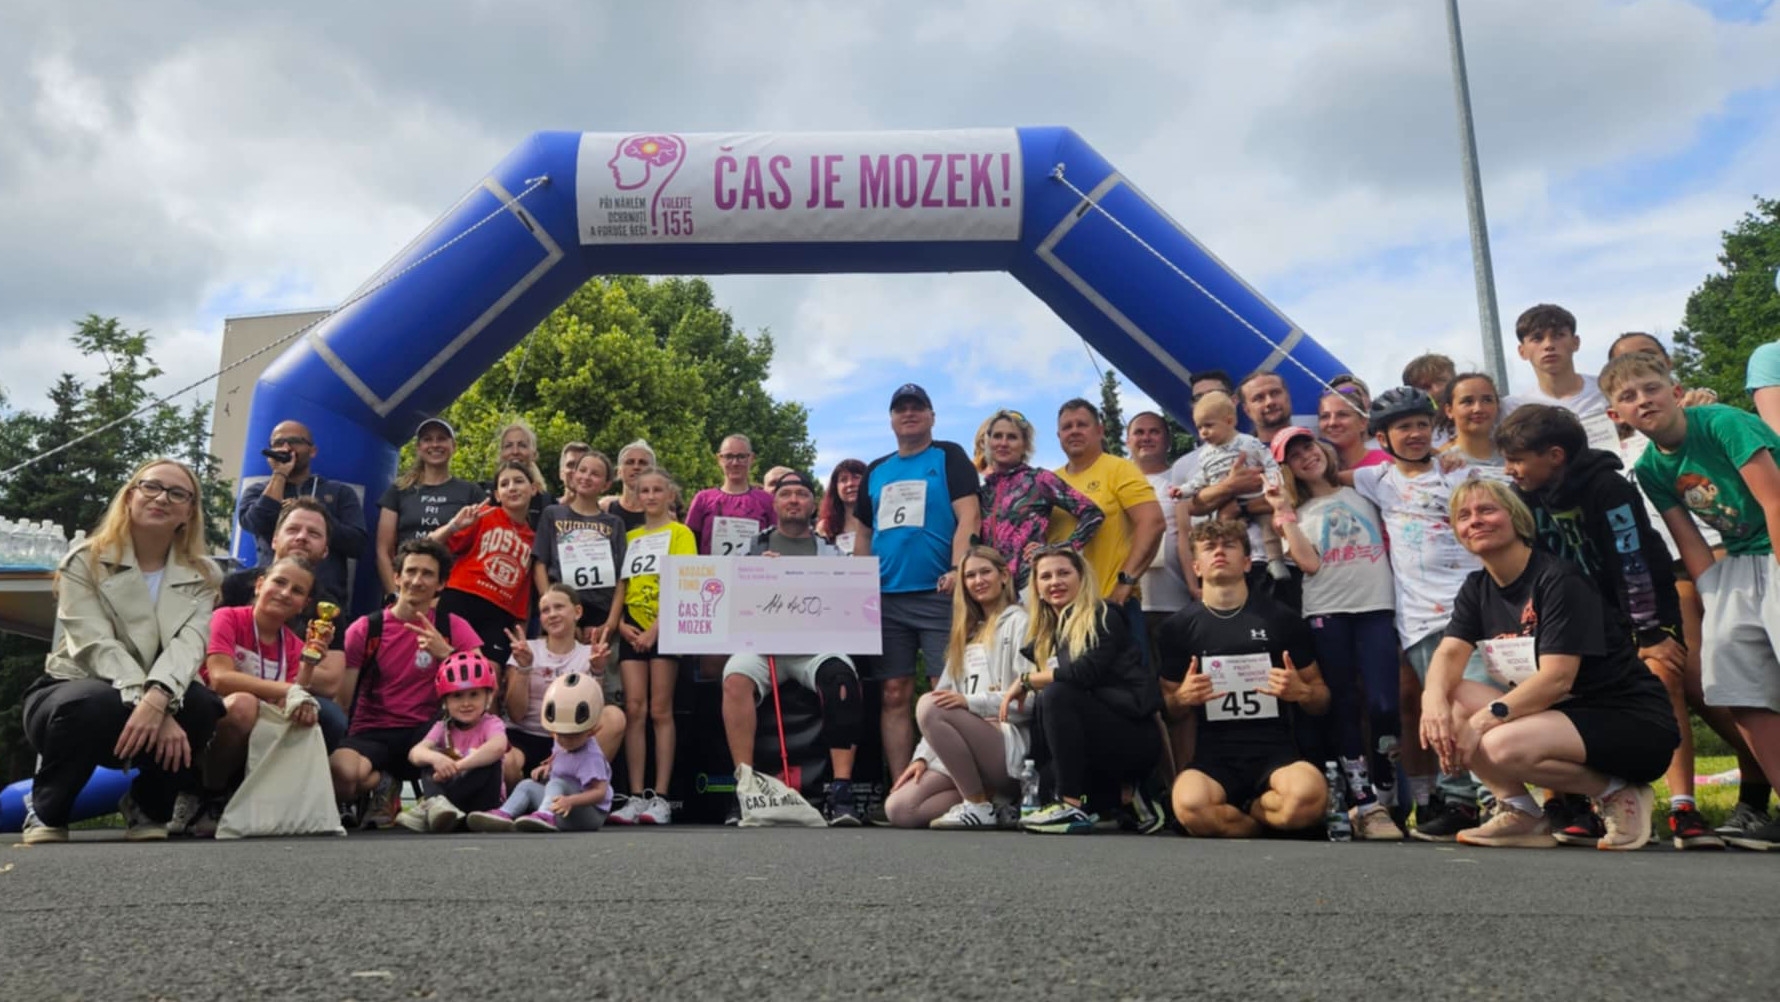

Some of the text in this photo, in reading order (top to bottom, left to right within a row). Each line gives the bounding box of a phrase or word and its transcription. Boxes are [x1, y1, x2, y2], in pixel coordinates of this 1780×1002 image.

[714, 146, 1011, 210] ČAS JE MOZEK!
[661, 196, 692, 209] VOLEJTE
[662, 210, 693, 236] 155
[420, 495, 447, 504] FAB
[425, 505, 439, 514] RI
[893, 506, 906, 525] 6
[421, 517, 441, 526] KA
[630, 554, 656, 574] 62
[574, 565, 604, 587] 61
[678, 600, 699, 618] ČAS
[701, 602, 712, 618] JE
[678, 619, 713, 634] MOZEK
[1221, 690, 1261, 717] 45
